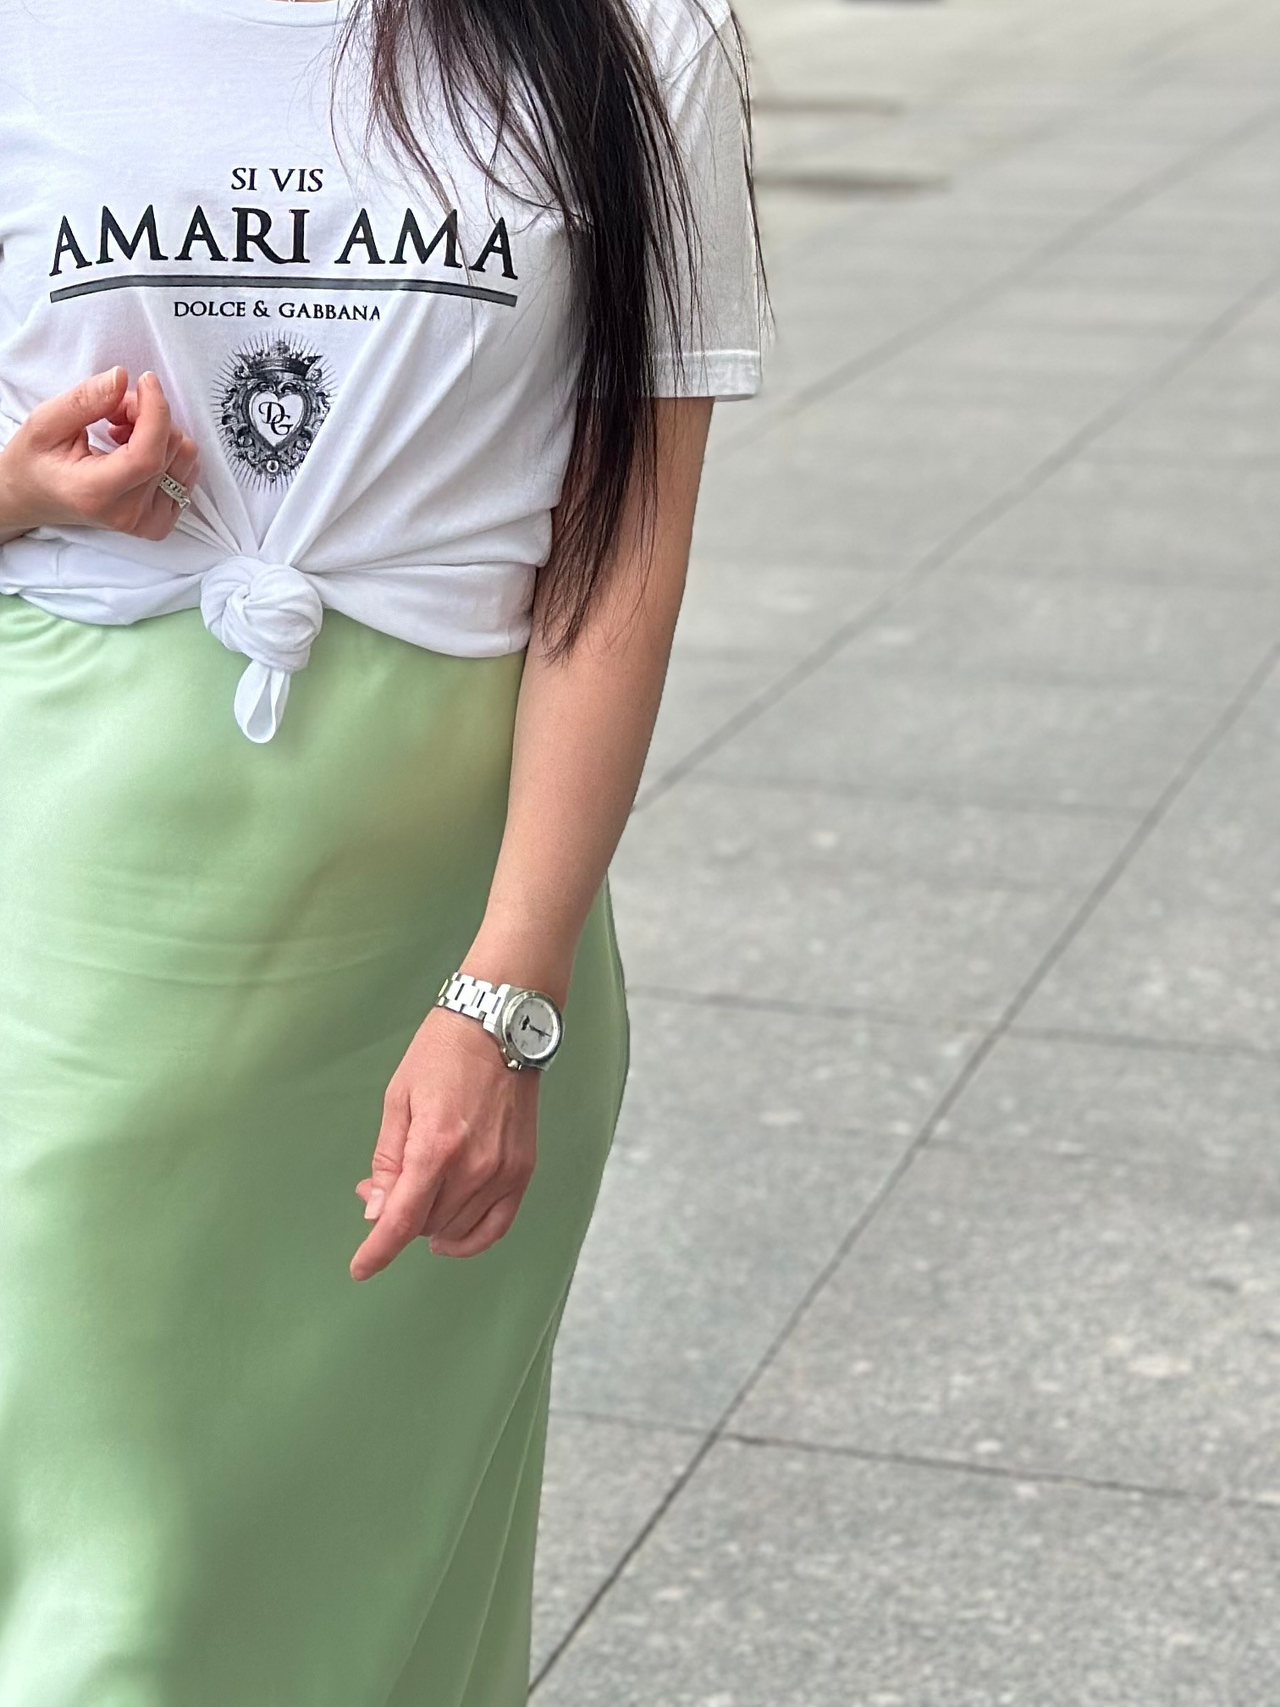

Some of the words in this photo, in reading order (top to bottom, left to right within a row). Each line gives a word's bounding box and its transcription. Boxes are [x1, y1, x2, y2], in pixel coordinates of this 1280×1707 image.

[231, 167, 258, 191] SI
[269, 168, 324, 193] VIS
[48, 205, 311, 277] AMARI
[333, 207, 519, 281] AMA
[173, 300, 246, 317] DOLCE
[252, 299, 271, 318] &
[278, 302, 382, 321] GABBANA
